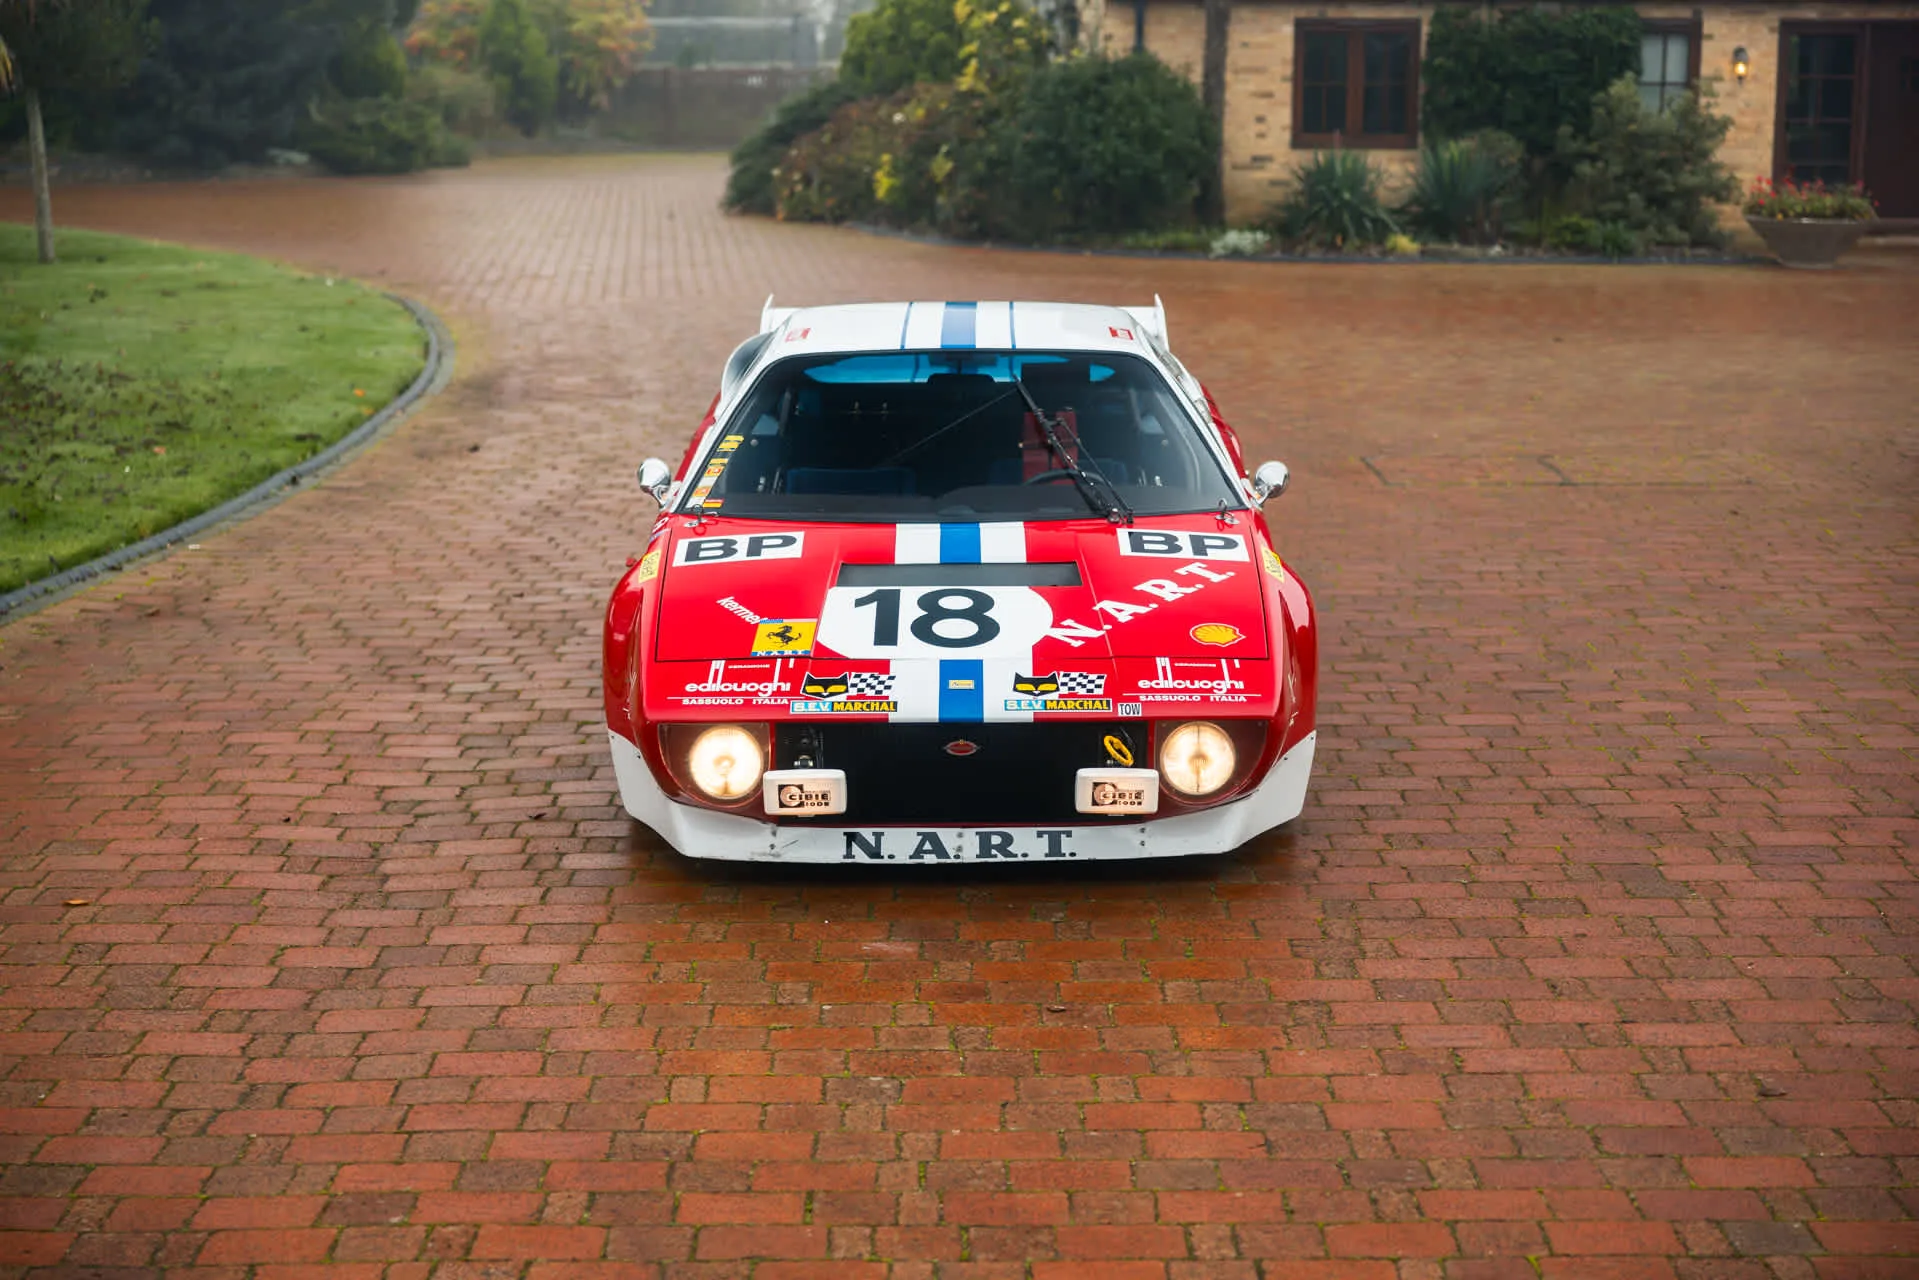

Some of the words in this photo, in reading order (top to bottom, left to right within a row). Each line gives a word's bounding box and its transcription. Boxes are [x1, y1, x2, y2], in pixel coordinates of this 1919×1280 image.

[684, 535, 797, 563] BP
[1128, 531, 1239, 557] BP
[1045, 561, 1236, 647] N.A.R.T.
[854, 588, 1000, 648] 18
[832, 701, 896, 712] MARCHAL
[1045, 699, 1109, 710] MARCHAL
[1119, 703, 1141, 716] TOW
[843, 830, 1077, 860] N.A.R.T.
